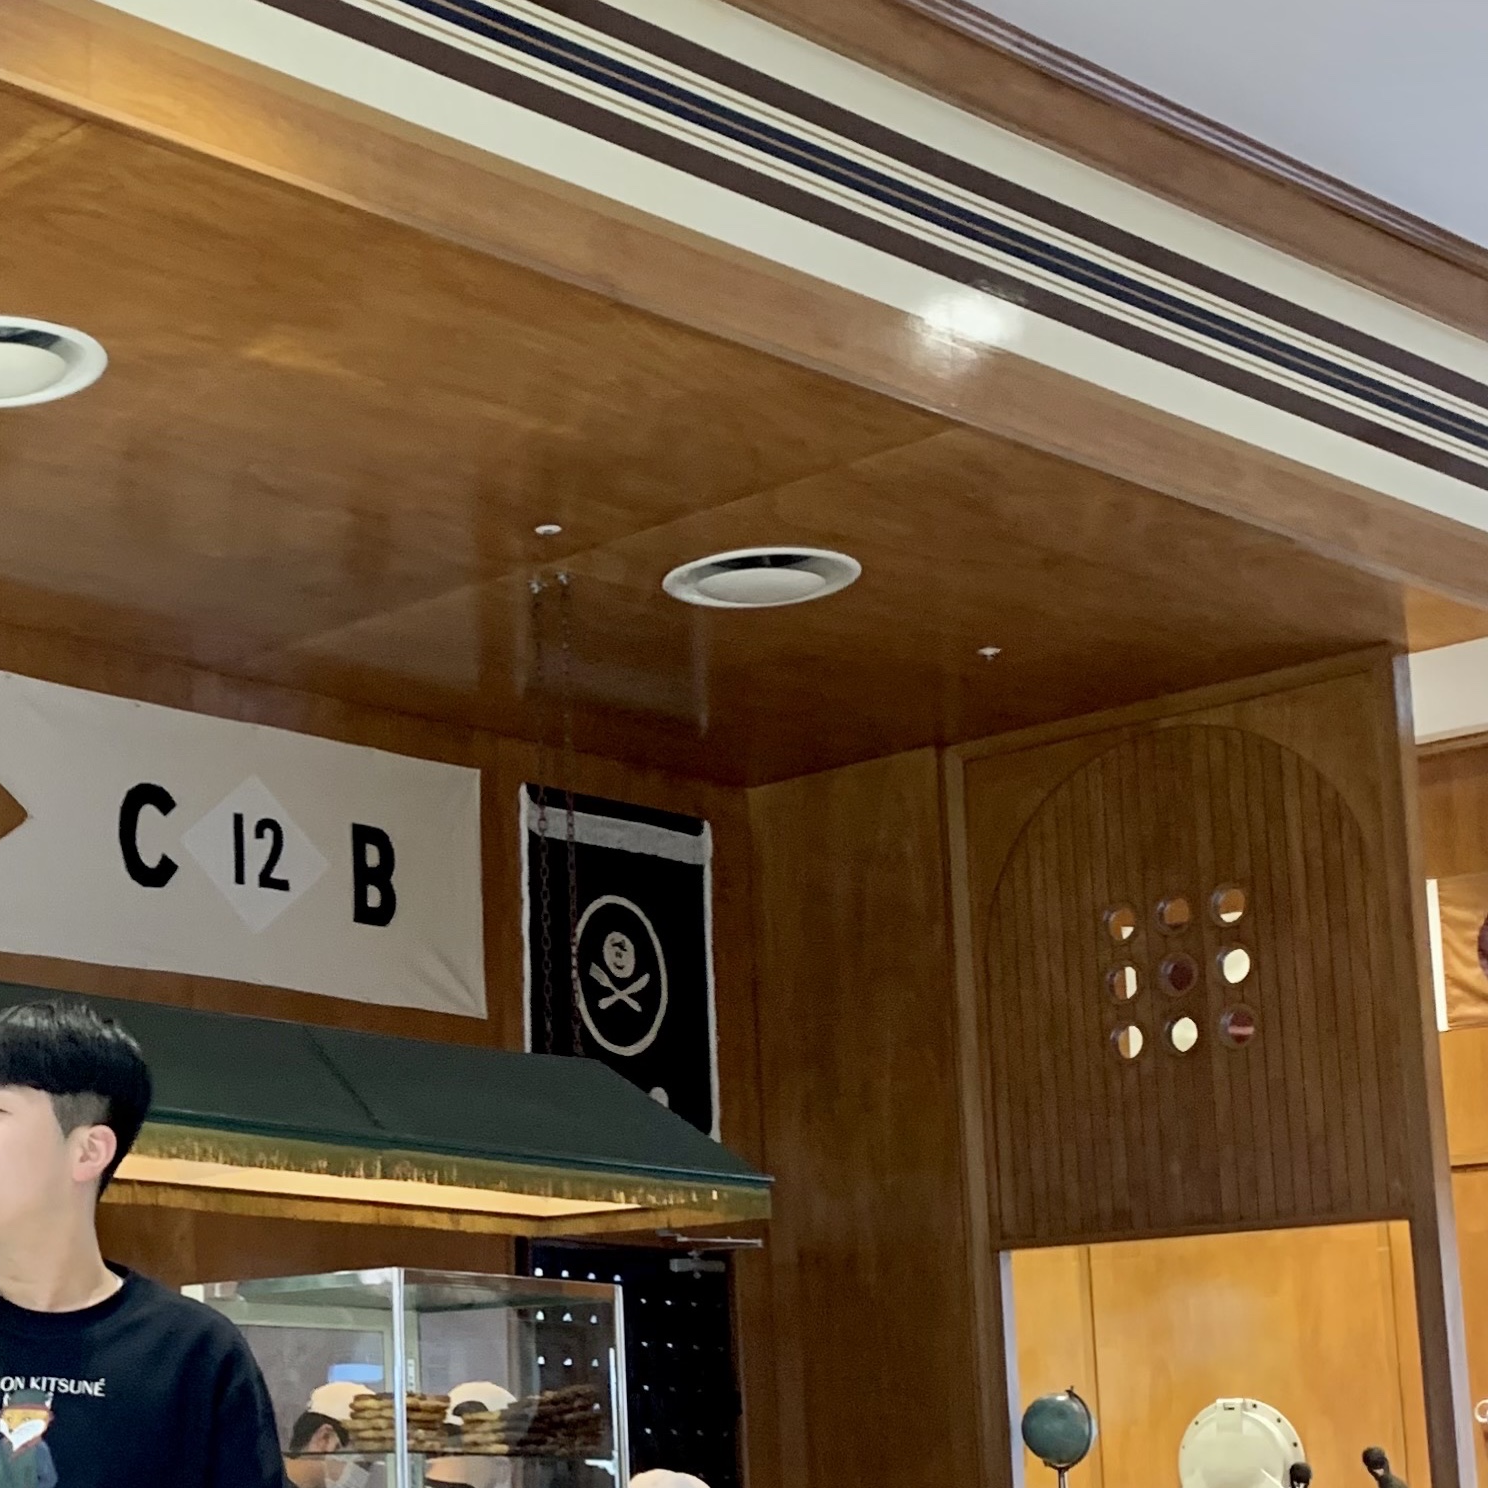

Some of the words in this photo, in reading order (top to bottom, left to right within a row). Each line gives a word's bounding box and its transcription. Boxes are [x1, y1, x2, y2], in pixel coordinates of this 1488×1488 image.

[119, 783, 179, 888] C
[233, 813, 290, 891] 12
[352, 822, 396, 927] B
[29, 1376, 106, 1397] KITSUNÉ
